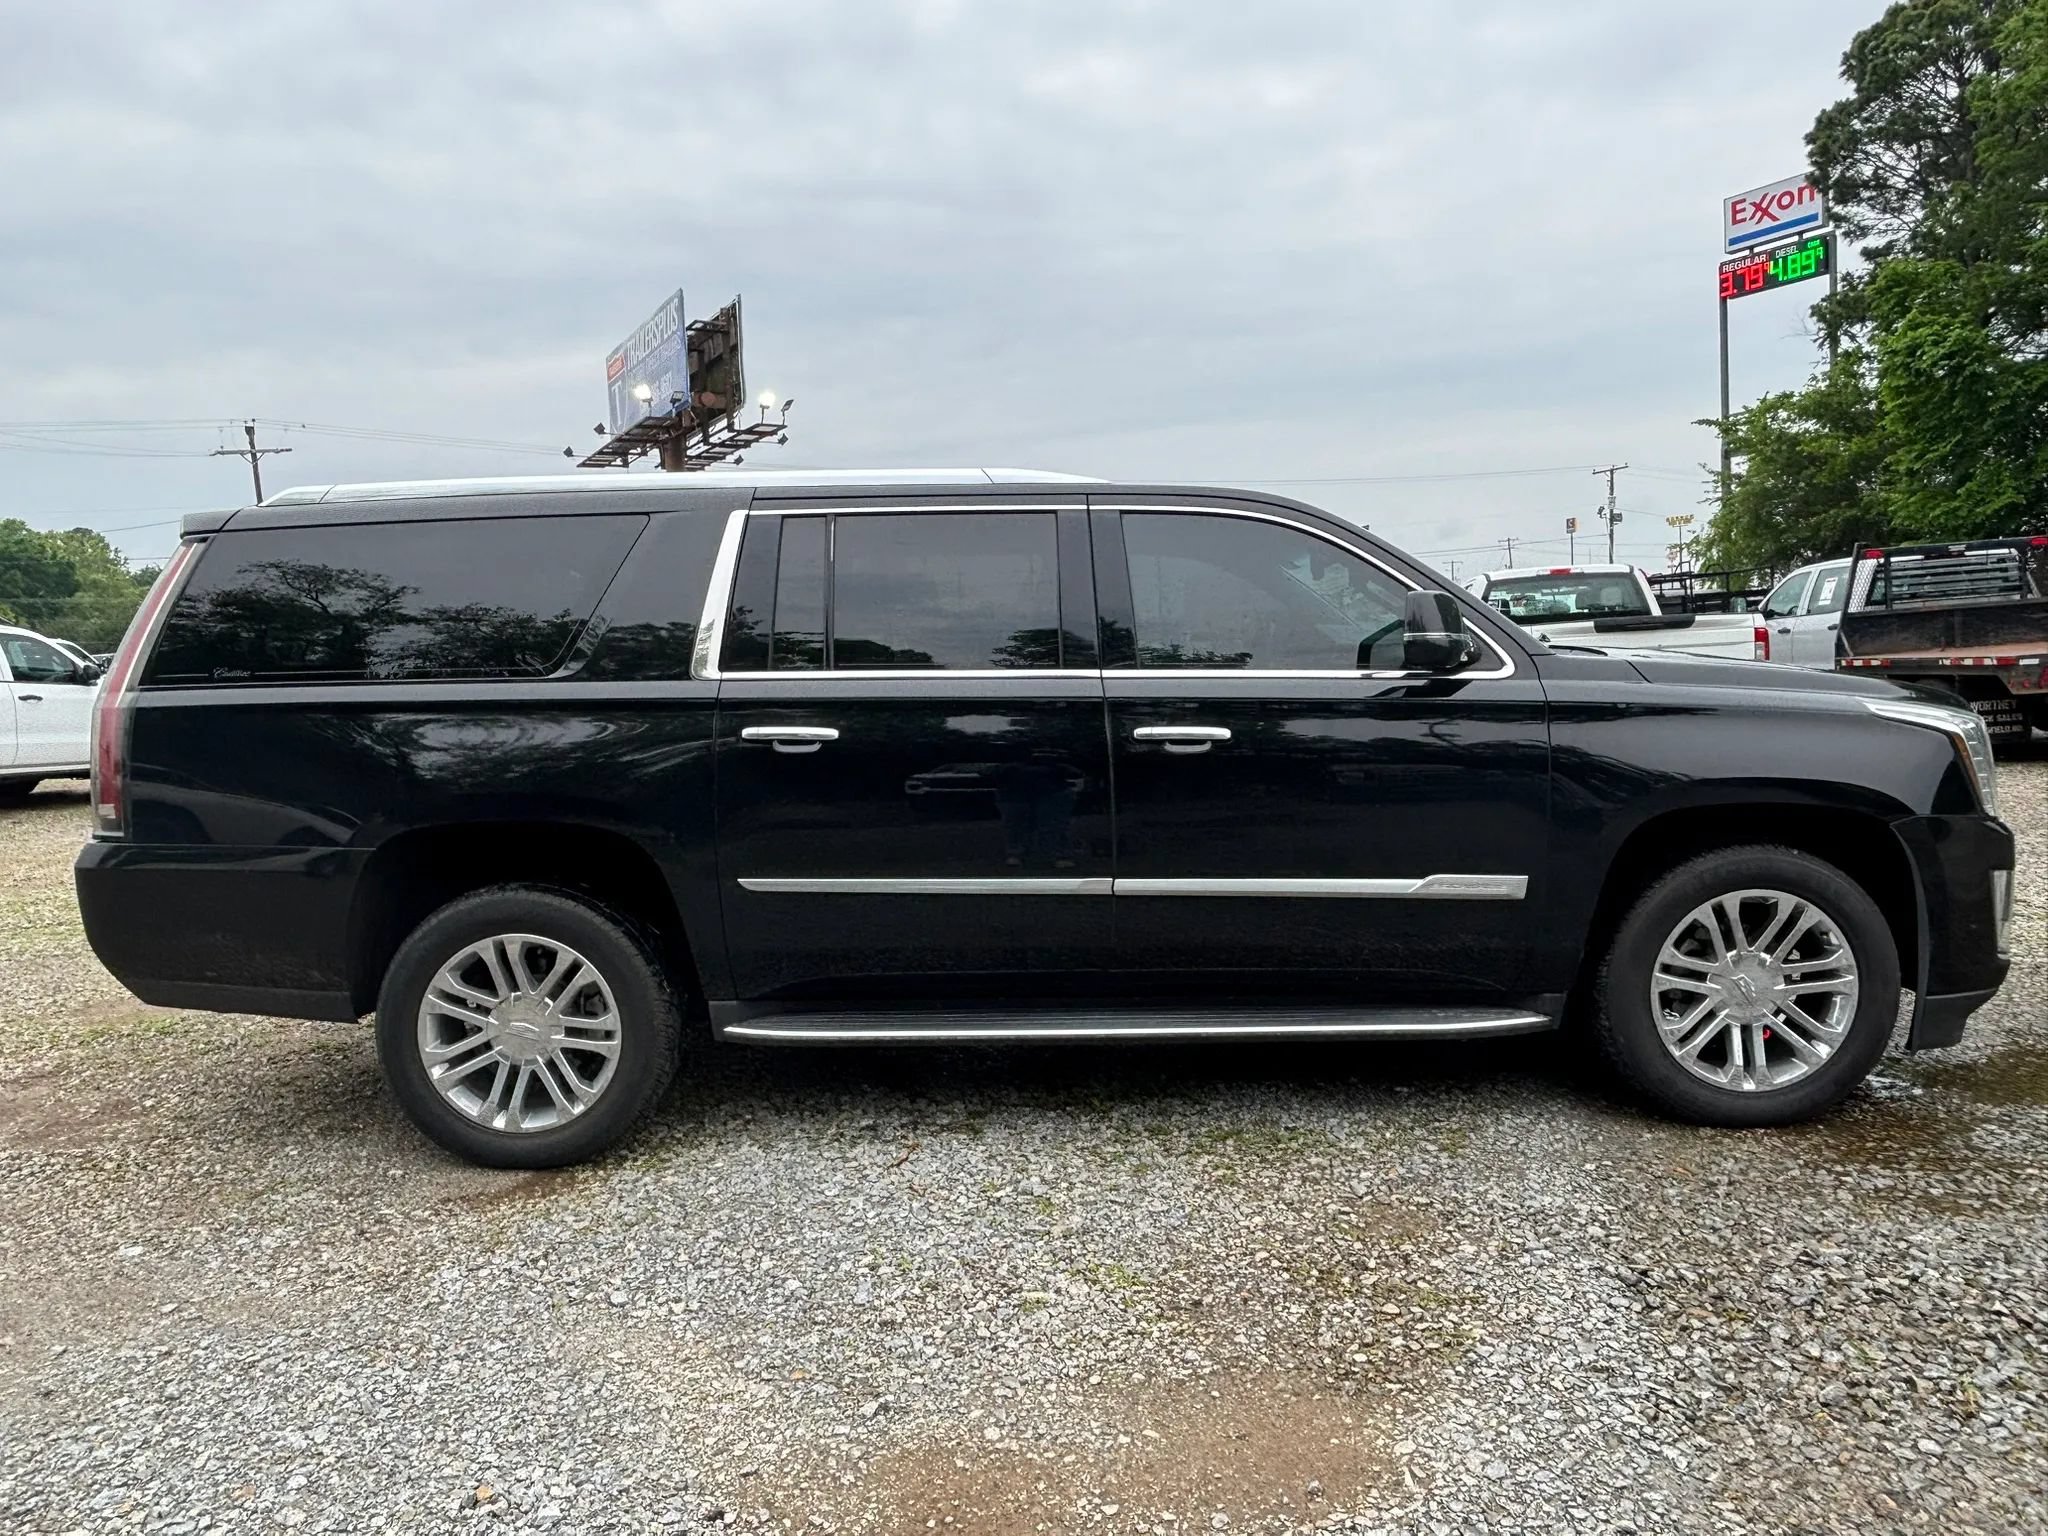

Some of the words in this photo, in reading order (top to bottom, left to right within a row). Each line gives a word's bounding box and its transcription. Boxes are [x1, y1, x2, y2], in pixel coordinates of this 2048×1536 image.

[1731, 183, 1817, 226] Exxon
[1776, 245, 1799, 259] DIESEL
[1723, 254, 1767, 273] REGULAR
